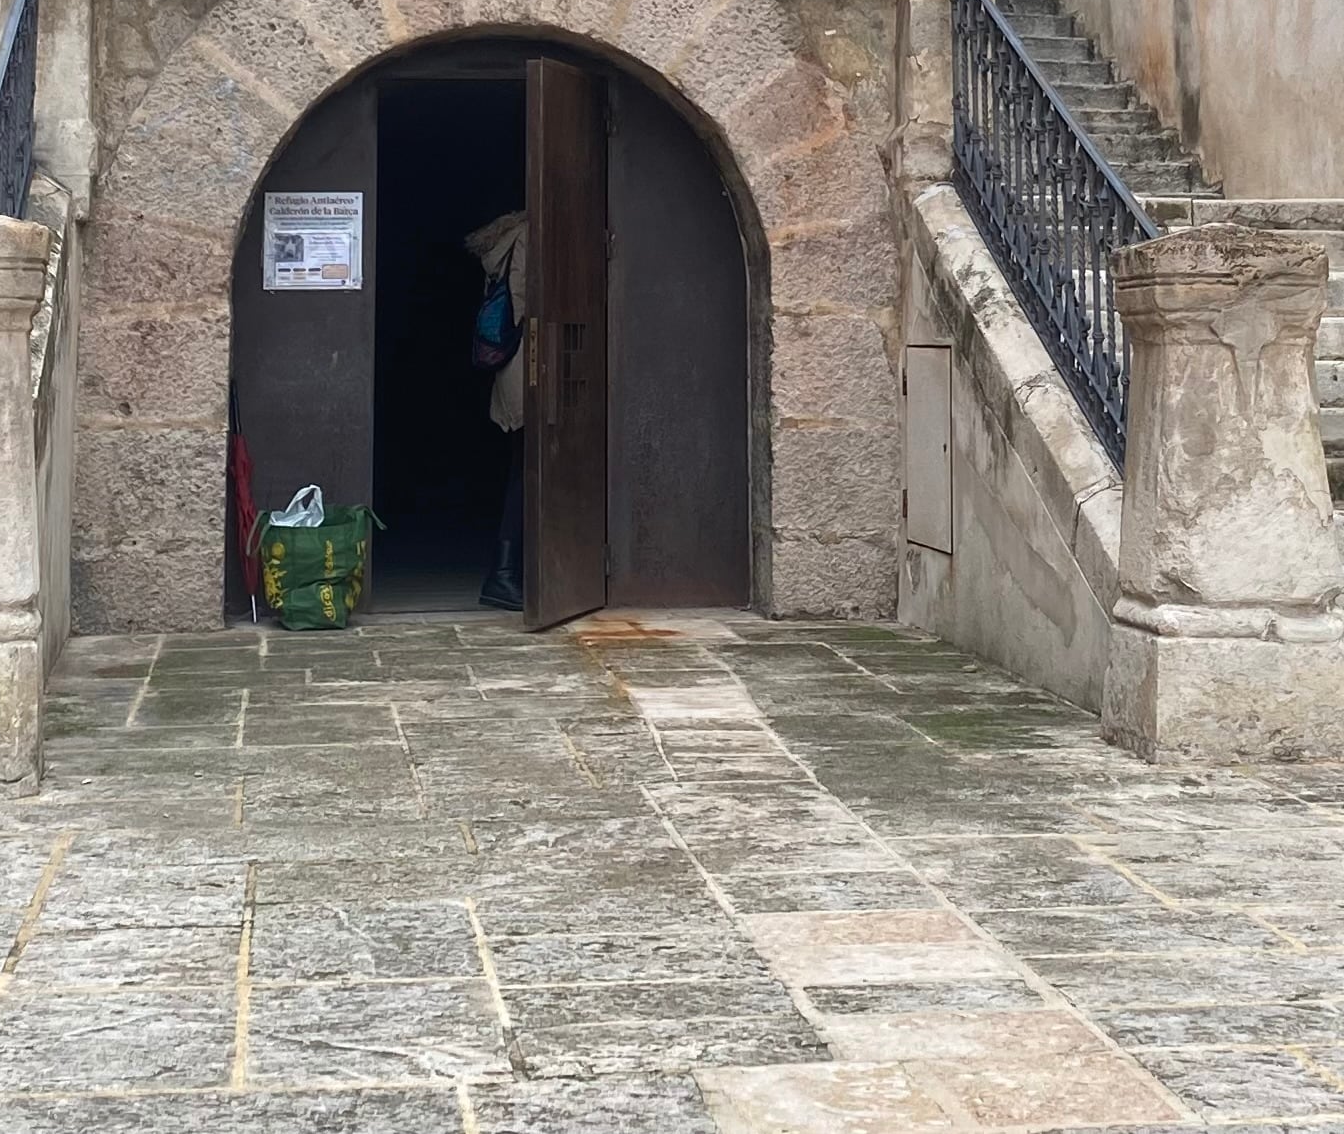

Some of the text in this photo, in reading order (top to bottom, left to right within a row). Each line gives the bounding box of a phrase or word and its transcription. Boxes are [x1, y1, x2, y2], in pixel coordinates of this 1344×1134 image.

[274, 196, 354, 206] Refugio Antiaéreo
[269, 207, 359, 216] Calderón de la Barca
